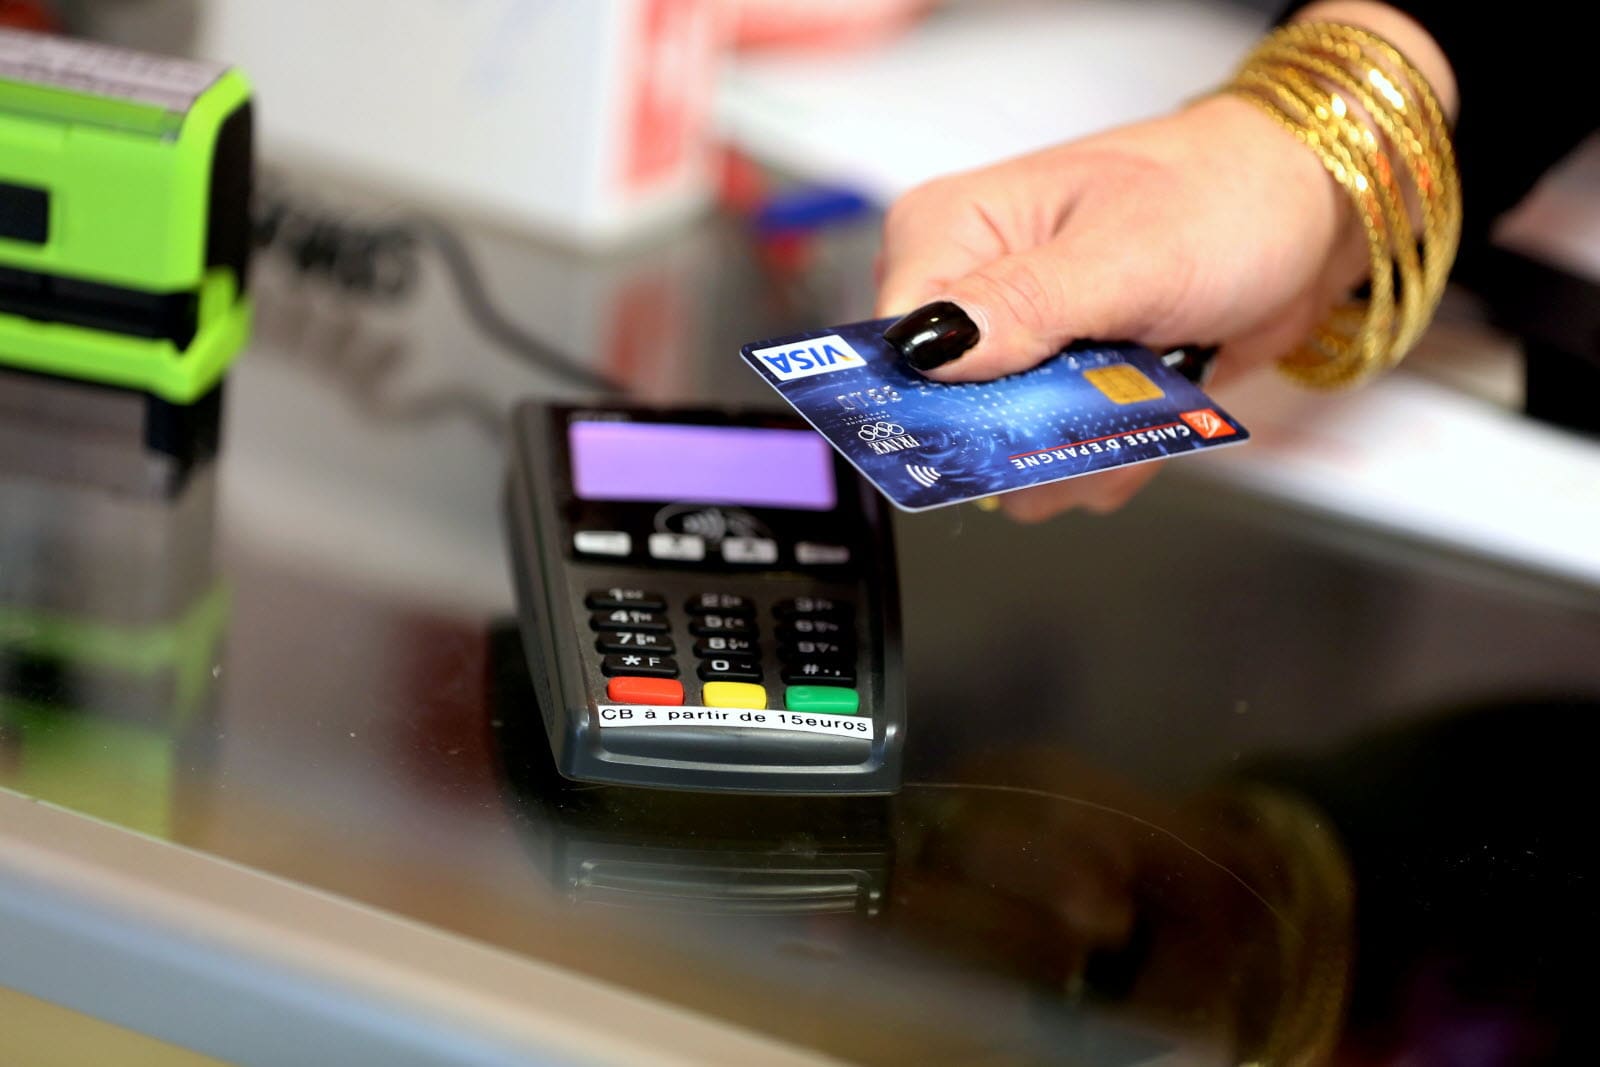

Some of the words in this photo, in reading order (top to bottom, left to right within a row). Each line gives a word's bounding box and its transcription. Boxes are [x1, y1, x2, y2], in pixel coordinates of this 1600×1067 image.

[763, 344, 853, 374] VISA
[867, 434, 921, 456] FRANCE
[1123, 424, 1191, 446] CAISSE
[1011, 441, 1121, 470] D'EPARGNE
[610, 610, 628, 623] 4
[616, 632, 632, 644] 7
[601, 708, 634, 720] CB
[644, 708, 657, 719] à
[668, 710, 728, 721] partir
[739, 711, 766, 723] de
[778, 714, 868, 732] 15euros
